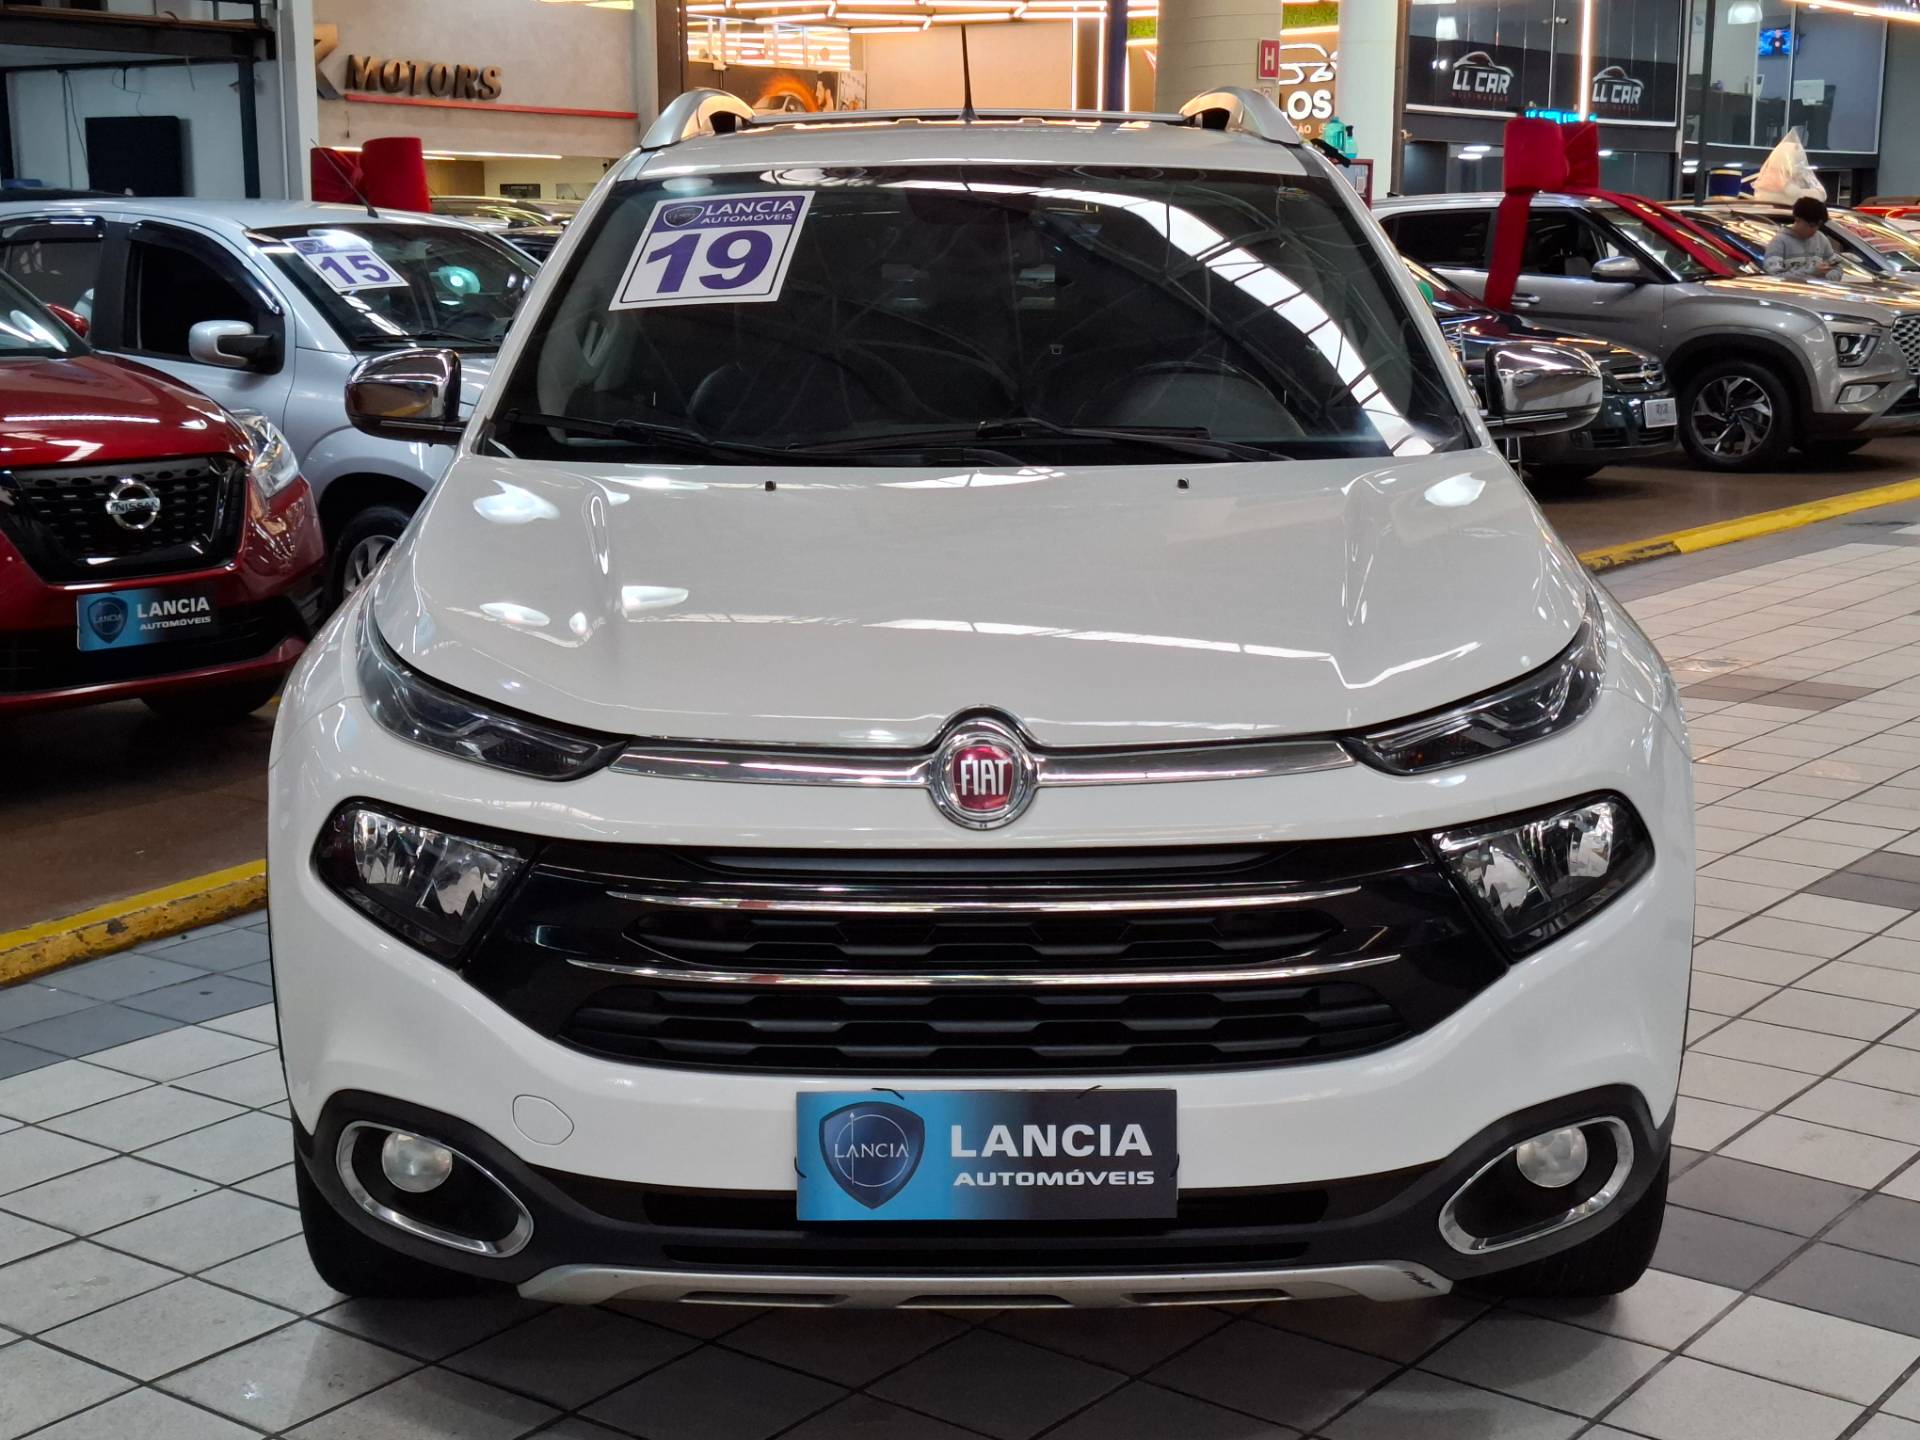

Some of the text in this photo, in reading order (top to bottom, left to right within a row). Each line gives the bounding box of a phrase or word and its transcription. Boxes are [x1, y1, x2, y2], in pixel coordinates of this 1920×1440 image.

[345, 54, 502, 100] MOTORS
[1452, 69, 1511, 95] LL CAR
[1592, 83, 1642, 104] LL CAR
[706, 201, 795, 215] LANCIA
[700, 213, 793, 225] AUTOMÓVEIS
[319, 255, 390, 284] 15
[647, 230, 772, 293] 19
[113, 501, 158, 512] NISSAN
[137, 597, 210, 617] LANCIA
[960, 759, 1008, 796] FIAT
[834, 1143, 909, 1158] LANCIA
[951, 1124, 1153, 1158] LANCIA
[953, 1170, 1155, 1187] AUTOMÓVEIS
